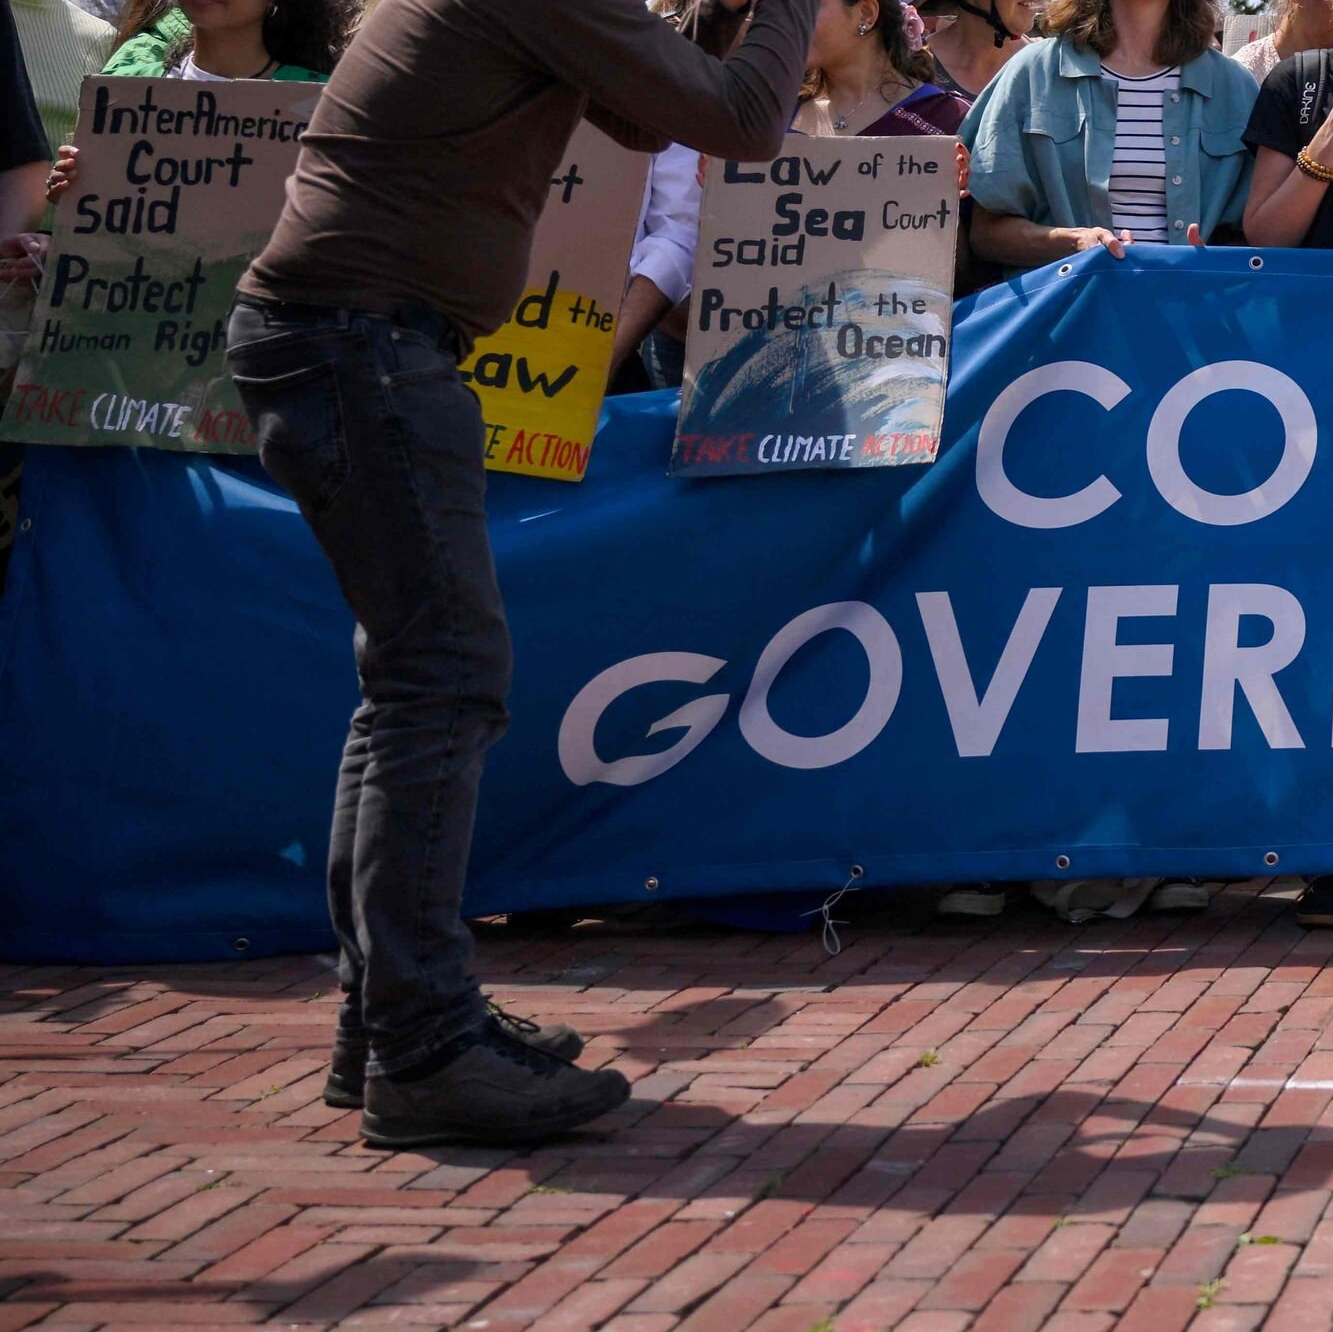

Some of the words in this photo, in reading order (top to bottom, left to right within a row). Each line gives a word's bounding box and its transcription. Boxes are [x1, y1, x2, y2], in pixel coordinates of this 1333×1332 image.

[1300, 82, 1316, 124] DAKINE
[126, 140, 253, 187] Court
[723, 156, 841, 187] Law
[858, 153, 884, 179] of
[896, 154, 938, 175] the
[73, 186, 180, 234] said
[772, 192, 865, 241] Sea
[882, 199, 950, 229] Court
[713, 234, 805, 267] said
[50, 253, 206, 314] Protect
[569, 295, 613, 332] the
[699, 282, 842, 332] Protect
[874, 292, 926, 316] the
[40, 319, 131, 353] Human
[837, 324, 946, 359] Ocean
[459, 352, 578, 397] aw
[15, 384, 86, 426] TAKE
[90, 393, 192, 437] CLIMATE
[505, 428, 591, 476] ACTION
[679, 433, 756, 463] TAKE
[758, 434, 857, 464] CLIMATE
[860, 433, 936, 456] ACTION
